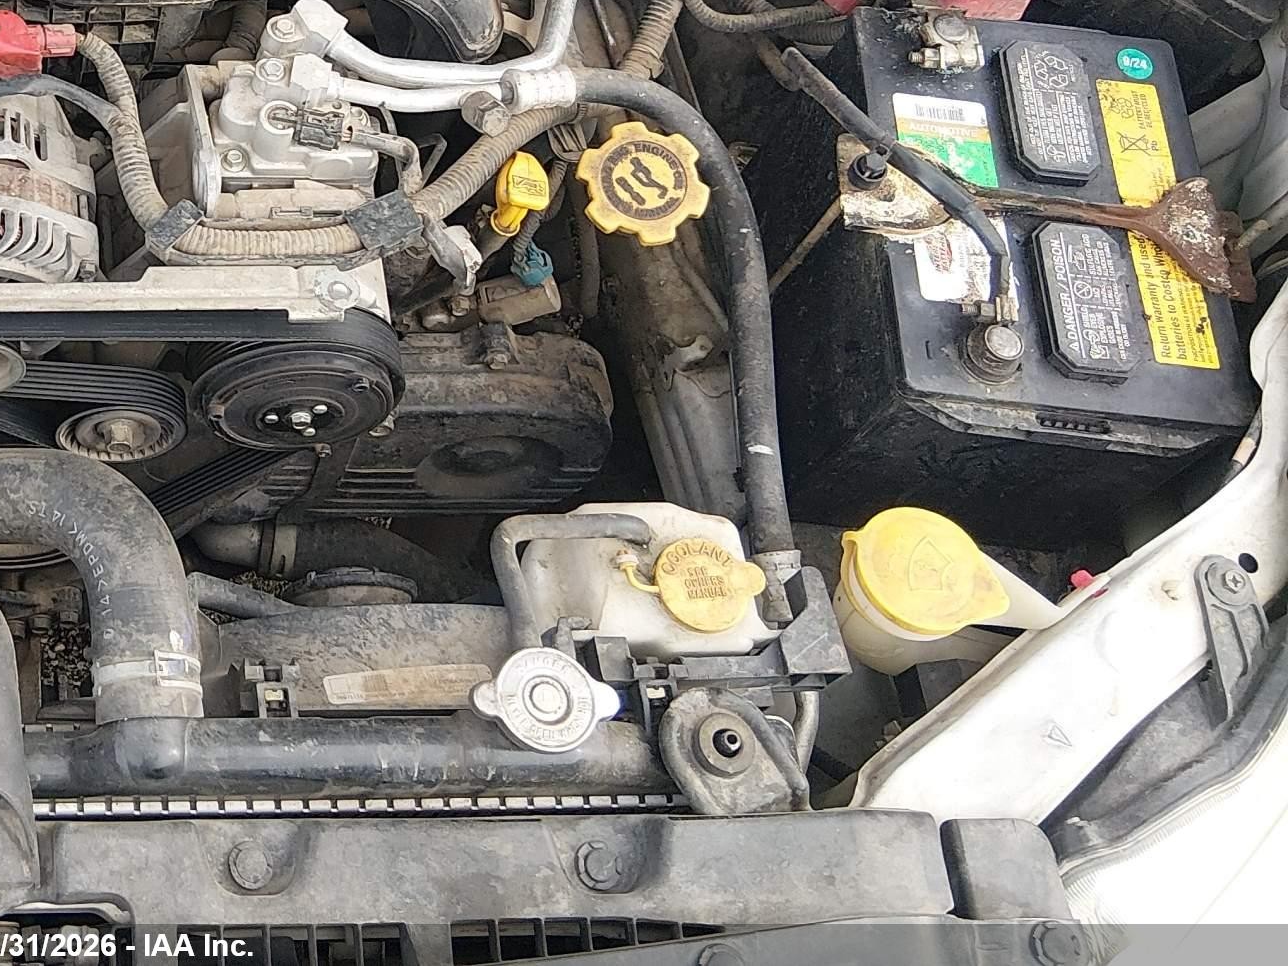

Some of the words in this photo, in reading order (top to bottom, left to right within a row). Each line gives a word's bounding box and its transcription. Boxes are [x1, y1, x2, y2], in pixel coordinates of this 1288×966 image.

[632, 142, 680, 171] ENGINE
[1050, 238, 1069, 281] POISON
[1137, 239, 1148, 261] used
[1146, 281, 1164, 323] warranty
[1160, 270, 1176, 301] Costco
[1059, 292, 1080, 343] DANGER
[1168, 304, 1177, 316] to
[1159, 324, 1171, 359] Return
[1171, 316, 1188, 361] batteries
[661, 541, 733, 575] COOLANT
